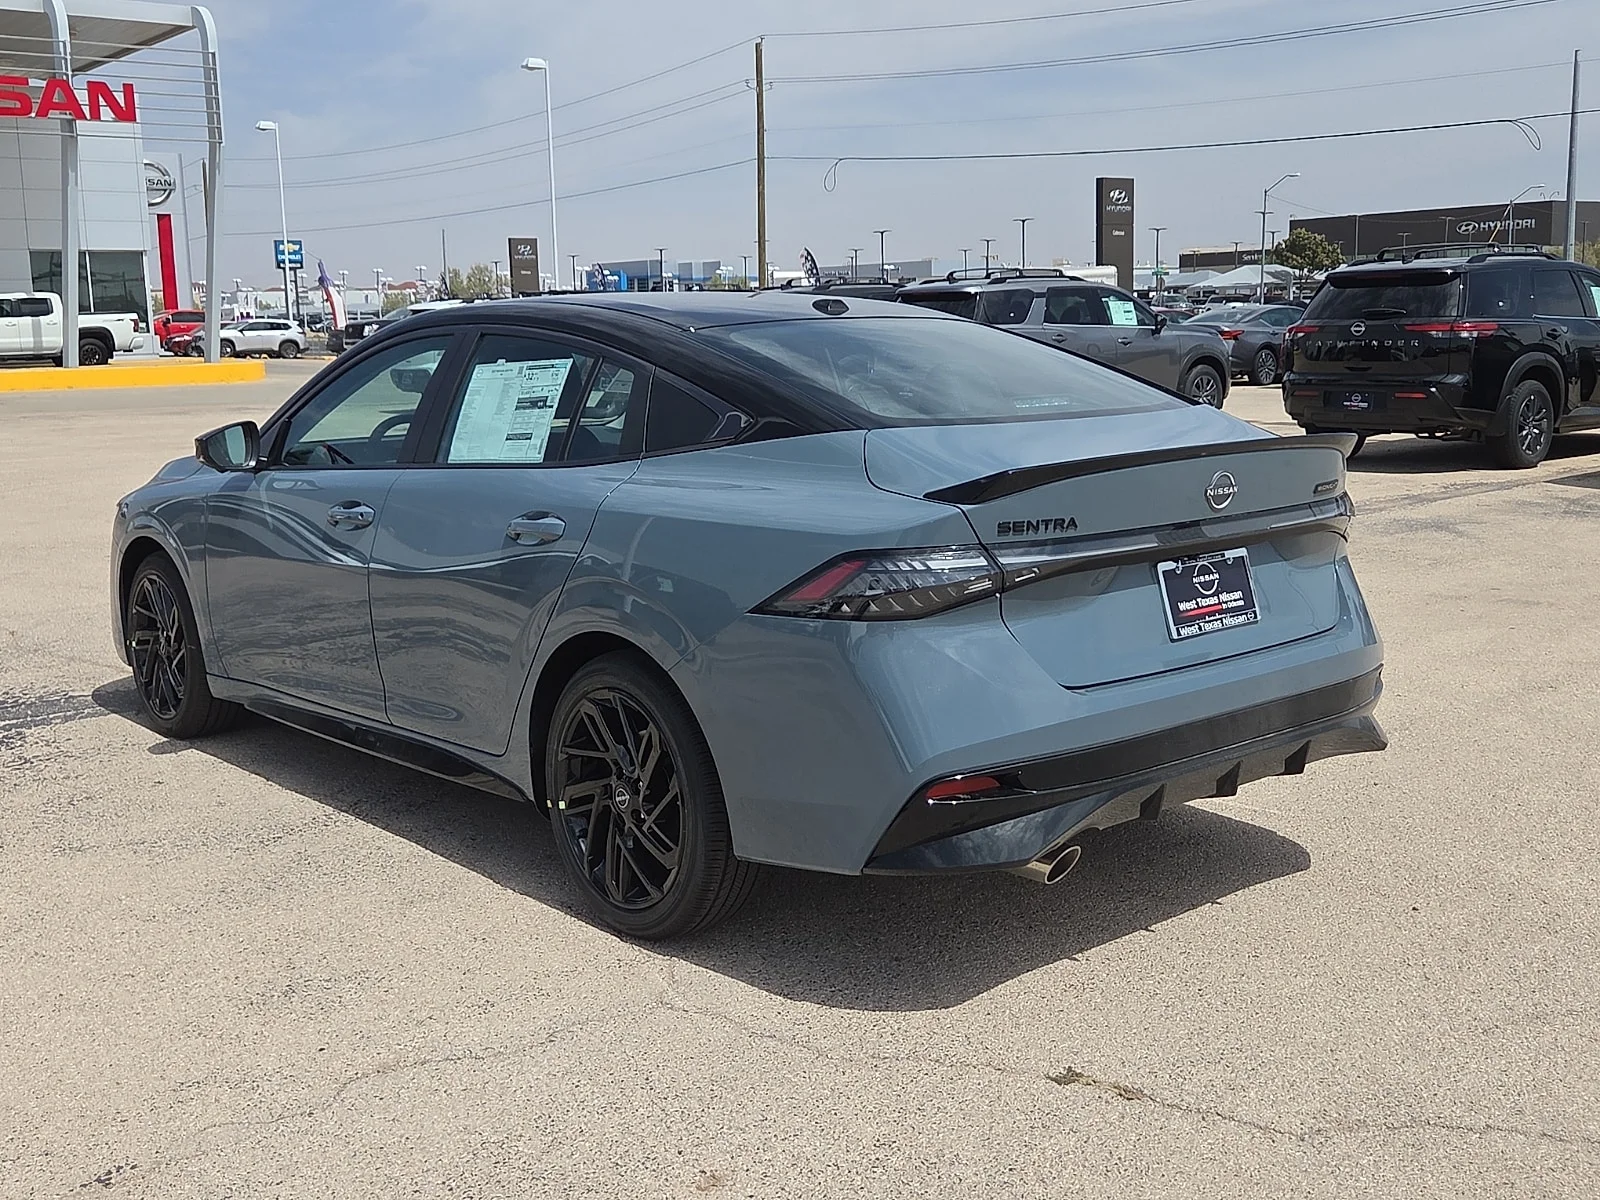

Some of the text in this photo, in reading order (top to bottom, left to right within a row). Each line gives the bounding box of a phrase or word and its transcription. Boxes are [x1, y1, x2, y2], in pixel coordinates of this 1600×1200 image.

[0, 75, 137, 122] SAN
[1480, 219, 1536, 232] HYUNDAI
[1306, 339, 1420, 348] PATHFINDER
[1207, 486, 1238, 496] NISSAN
[997, 516, 1078, 537] SENTRA
[1193, 573, 1219, 583] NISSAN
[1178, 591, 1243, 611] West Texas Nissan
[1179, 624, 1200, 636] West
[1199, 620, 1222, 631] Texas
[1222, 615, 1247, 626] Nissan
